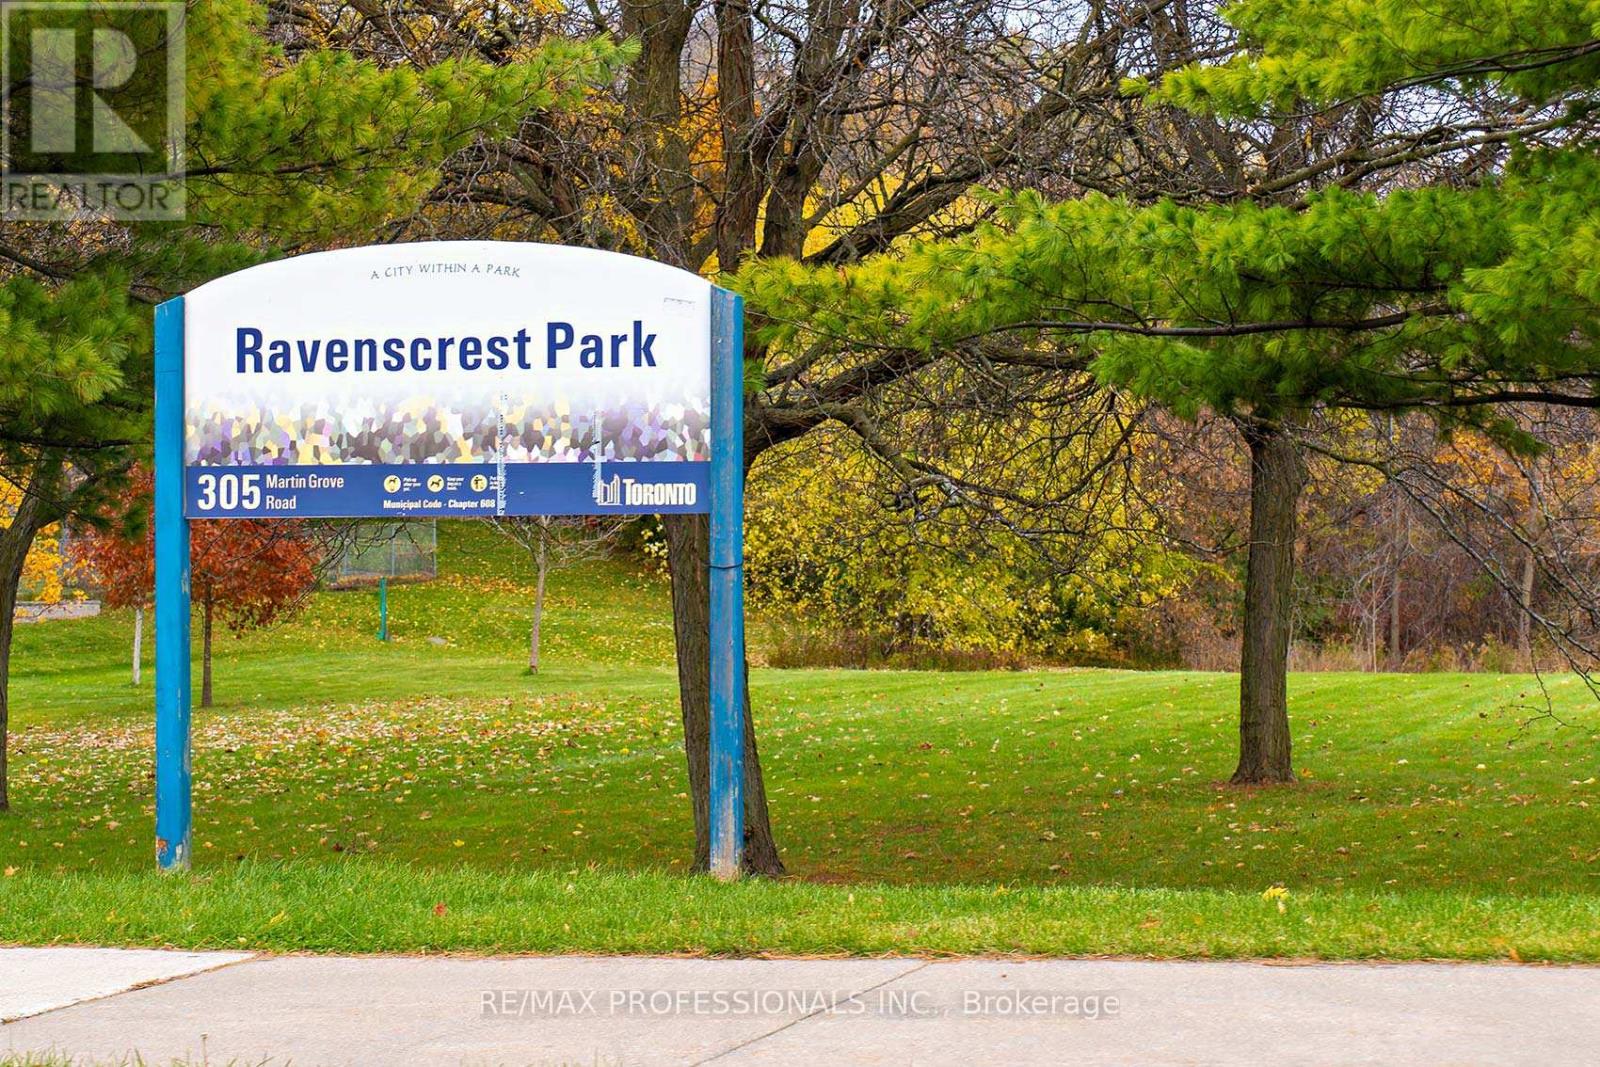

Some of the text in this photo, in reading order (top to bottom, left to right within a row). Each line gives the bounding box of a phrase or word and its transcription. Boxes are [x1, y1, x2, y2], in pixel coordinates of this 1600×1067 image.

[371, 263, 520, 280] A CITY WITHIN A PARK
[236, 320, 657, 374] Ravenscrest Park
[266, 474, 344, 489] Martin Grove
[197, 474, 261, 510] 305
[266, 496, 296, 510] Road
[383, 500, 421, 510] Municipal
[423, 500, 442, 508] Code
[448, 499, 479, 510] Chapter
